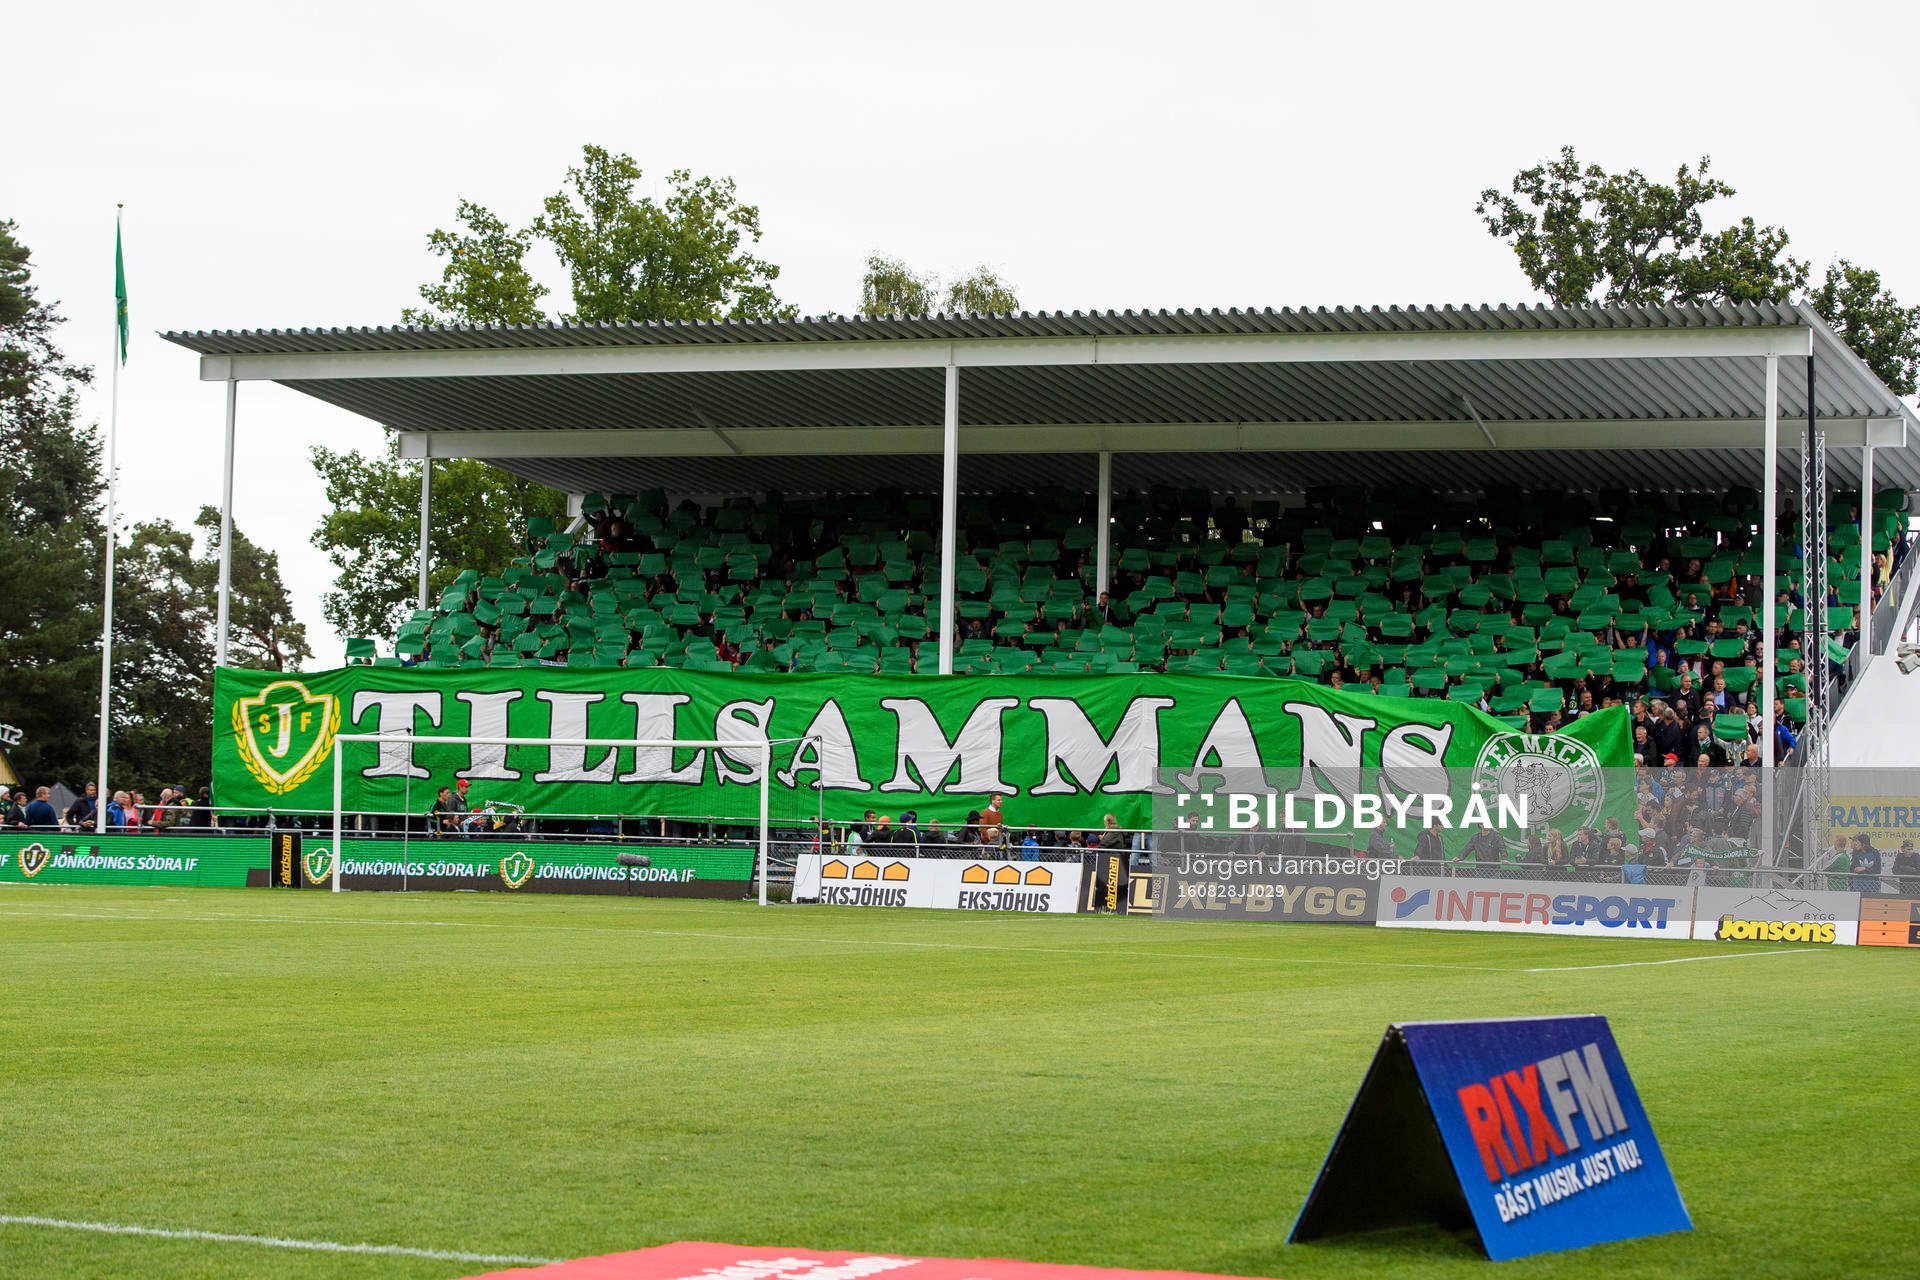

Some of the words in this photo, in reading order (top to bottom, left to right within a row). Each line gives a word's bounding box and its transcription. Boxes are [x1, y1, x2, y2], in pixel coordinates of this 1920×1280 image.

[351, 688, 1454, 817] TILLSAMMANS
[1885, 831, 1907, 839] THAN
[136, 854, 183, 871] SÖDRA
[184, 857, 199, 871] IF
[281, 834, 292, 886] gårdsman
[339, 859, 425, 876] JÖNKÖPINGS
[426, 860, 474, 877] SÖDRA
[476, 863, 491, 877] IF
[534, 862, 627, 881] JÖNKÖPINGS
[680, 868, 696, 883] IF
[820, 884, 908, 907] EKSJÖHUS
[1105, 856, 1120, 911] gårdsman
[957, 888, 1051, 912] EKSJÖHUS
[1172, 880, 1367, 917] XL-BYGG
[1434, 888, 1676, 930] INTERSPORT
[1715, 914, 1837, 943] Jonsons
[1803, 912, 1836, 922] BYGG
[1494, 1178, 1538, 1224] BÄST
[1537, 1163, 1585, 1208] MUSIK
[1582, 1151, 1616, 1187] JUST
[1613, 1139, 1643, 1175] NU!
